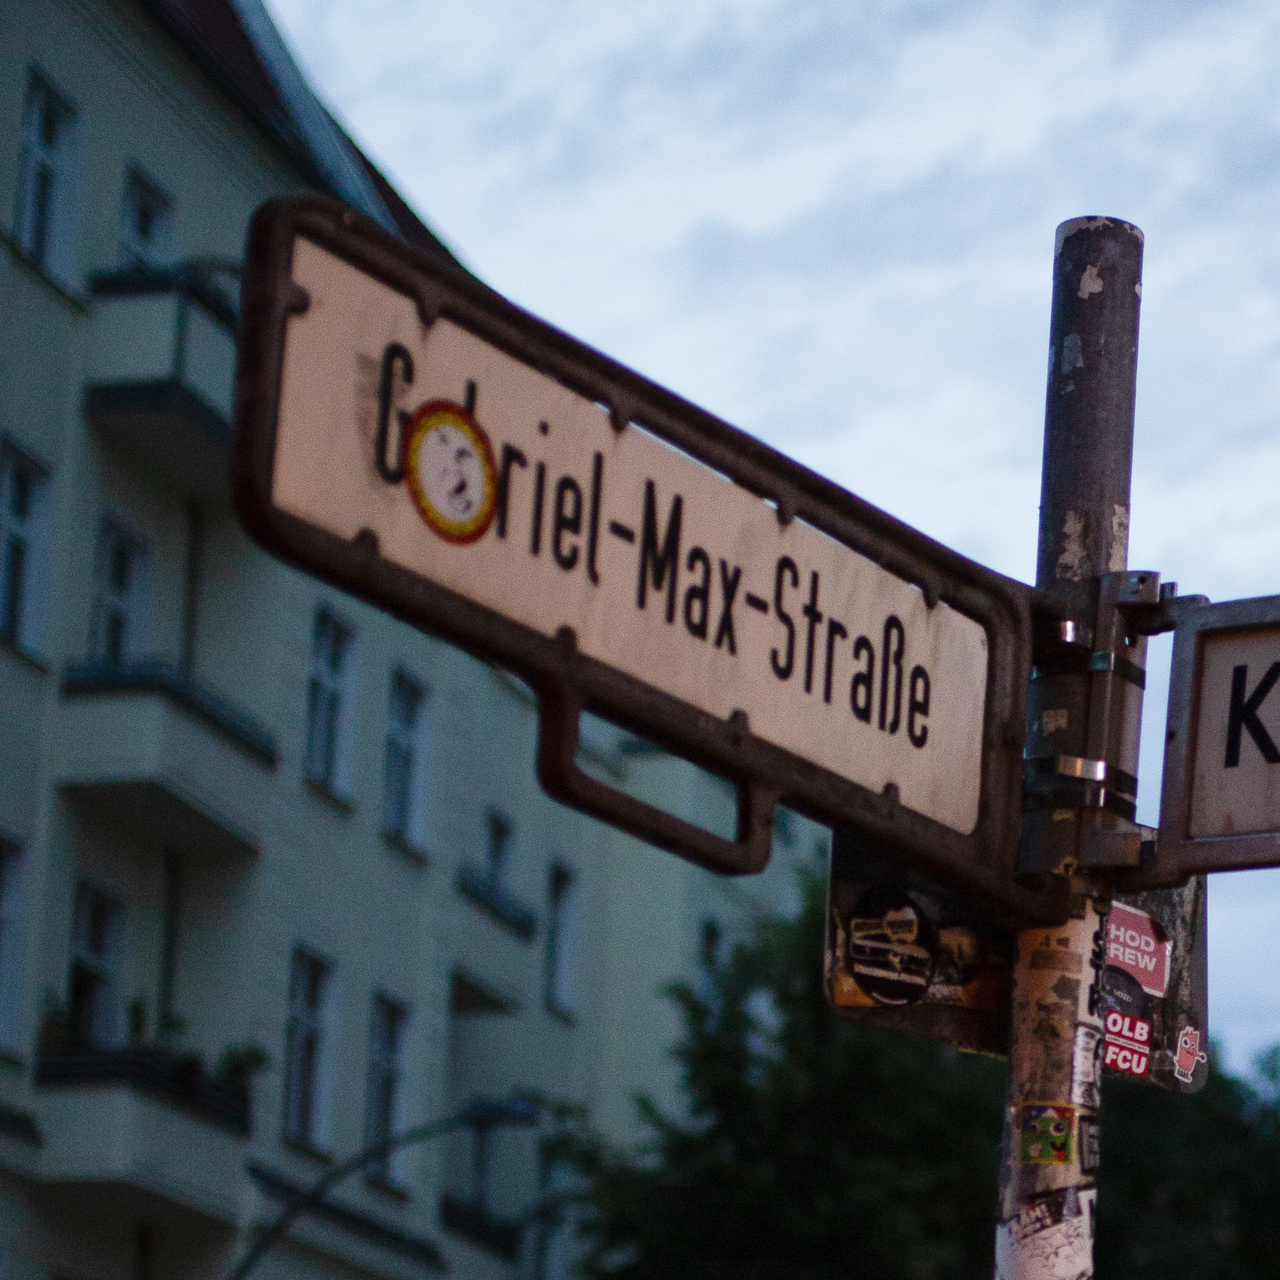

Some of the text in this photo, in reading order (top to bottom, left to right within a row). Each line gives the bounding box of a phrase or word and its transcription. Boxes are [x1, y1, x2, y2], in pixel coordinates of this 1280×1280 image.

[374, 341, 931, 750] Griel-Max-Straße
[1107, 923, 1155, 952] HOD
[1107, 942, 1157, 972] REW
[1106, 1012, 1150, 1042] OLB
[1105, 1045, 1147, 1074] FCU
